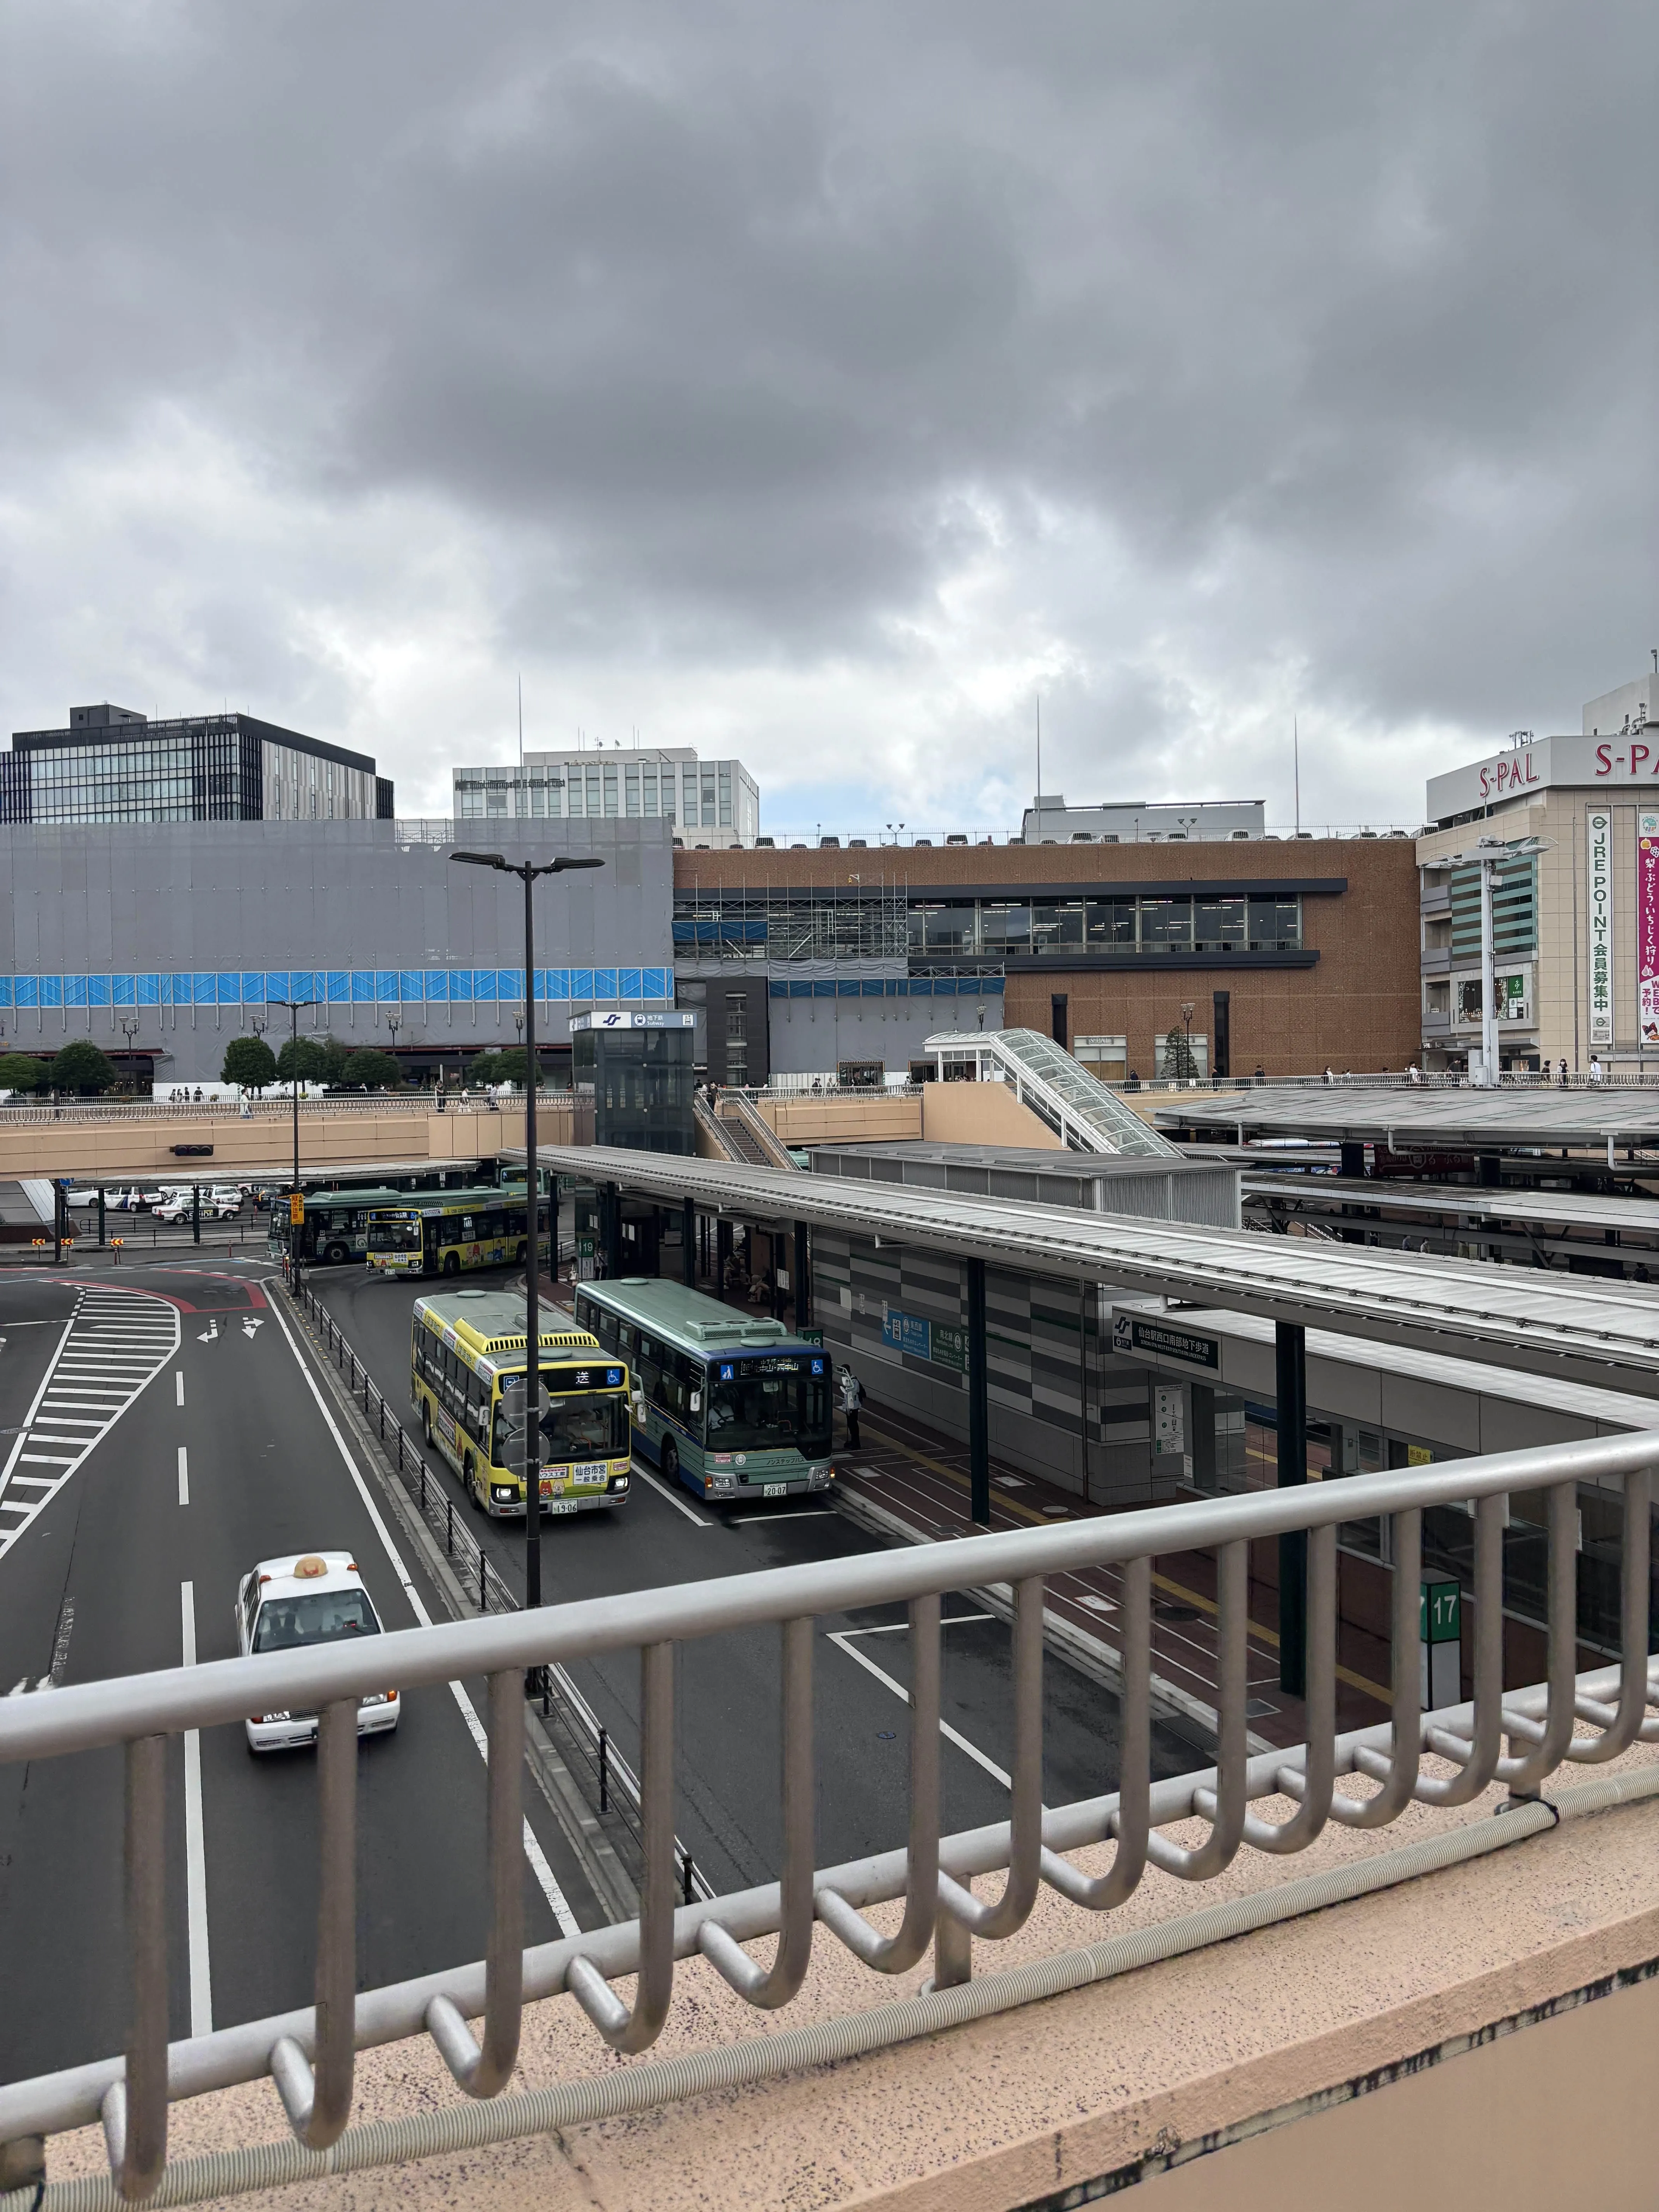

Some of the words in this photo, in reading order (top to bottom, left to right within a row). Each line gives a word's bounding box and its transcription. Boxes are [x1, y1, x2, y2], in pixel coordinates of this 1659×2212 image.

[1480, 753, 1539, 797] S-PAL
[1595, 744, 1659, 775] S-P
[1594, 832, 1606, 871] JRE
[1645, 858, 1656, 965] 梨・ぶどう・いちじく狩り
[1593, 876, 1608, 1012] POINT会員募集中
[583, 1242, 593, 1252] 19
[1138, 1326, 1209, 1355] 仙台駅西口南部地下歩道
[575, 1464, 606, 1476] 仙台市営
[766, 1457, 805, 1465] ノンステップバス
[1434, 1594, 1456, 1625] 17
